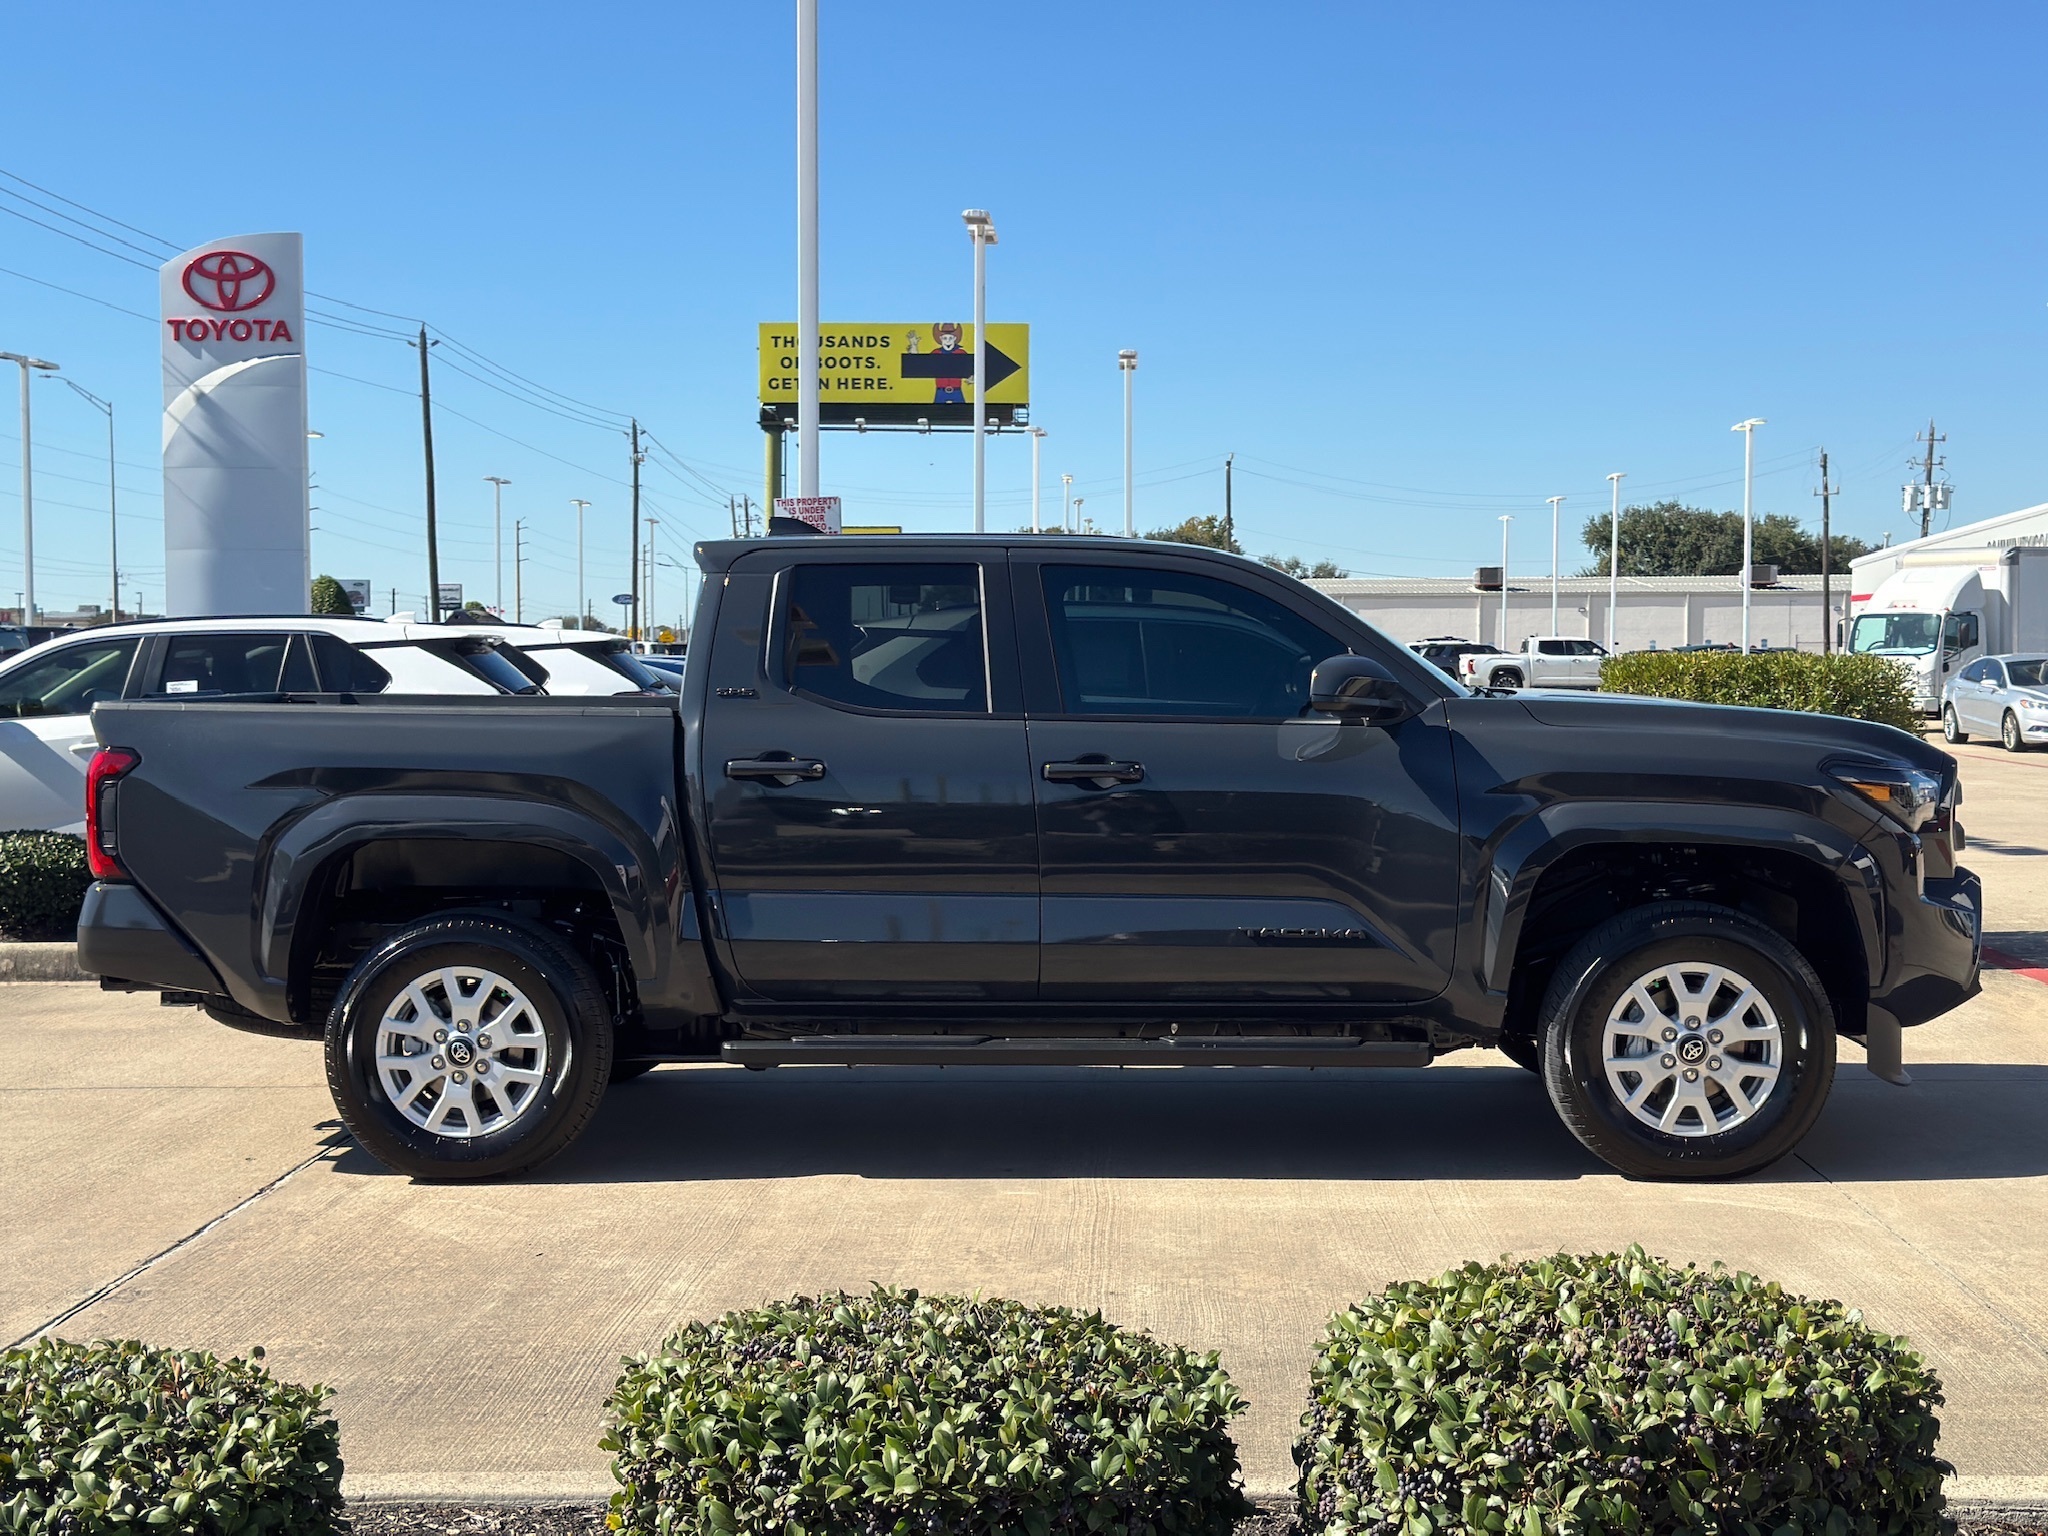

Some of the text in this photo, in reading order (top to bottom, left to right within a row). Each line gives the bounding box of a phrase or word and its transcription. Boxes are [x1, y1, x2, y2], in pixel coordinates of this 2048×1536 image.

[166, 318, 293, 342] TOYOTA
[771, 335, 891, 348] THSANDS
[837, 377, 894, 390] HERE.
[776, 497, 838, 507] THIS PROPERTY
[788, 506, 826, 515] IS UNDER
[803, 515, 825, 523] HOUR
